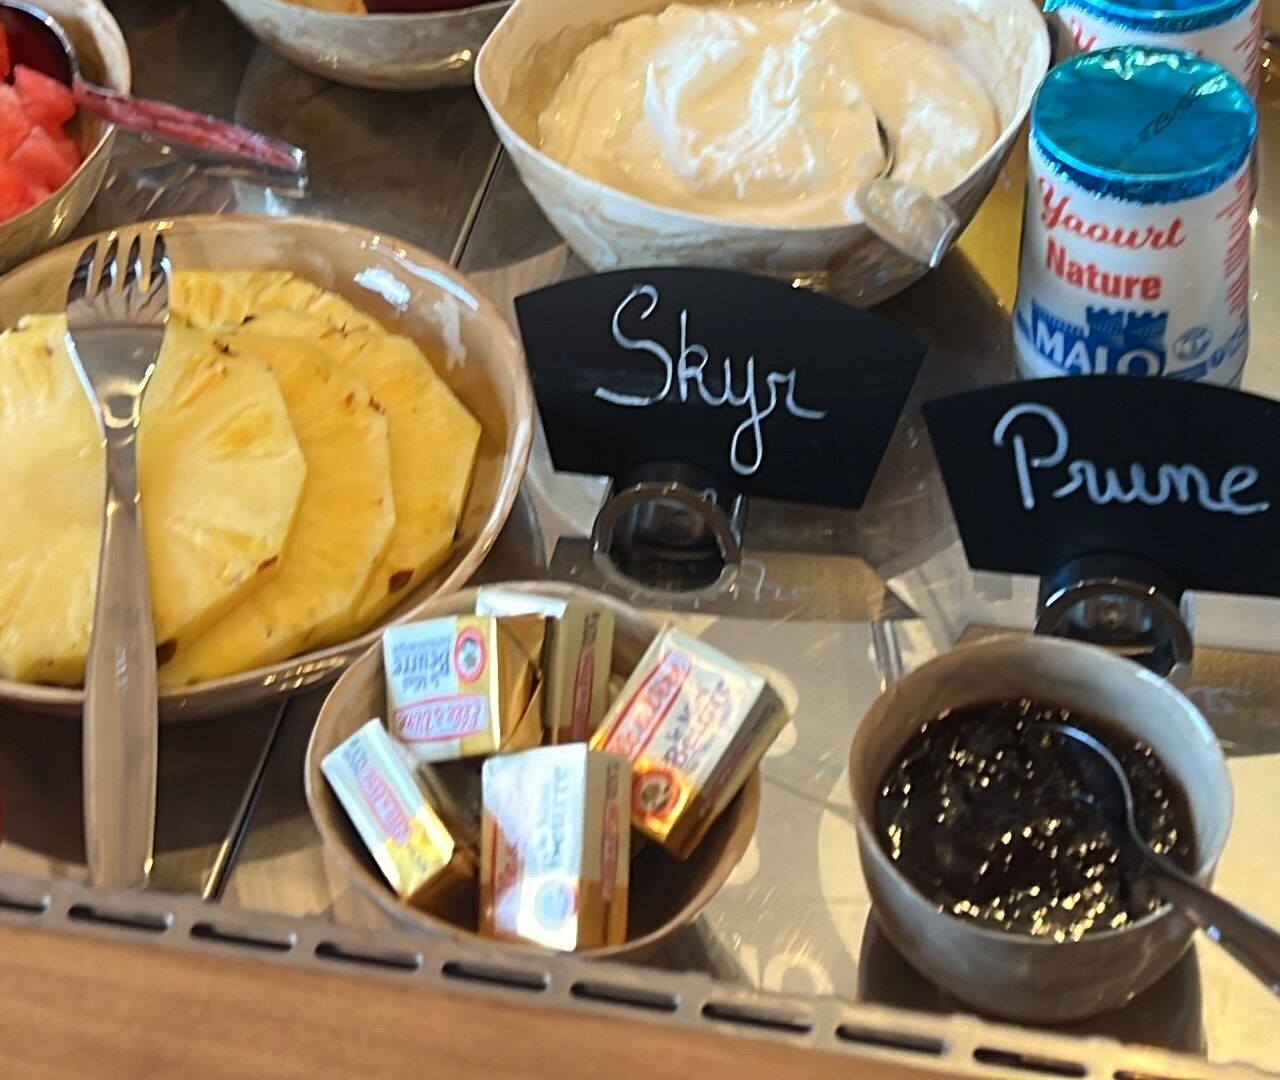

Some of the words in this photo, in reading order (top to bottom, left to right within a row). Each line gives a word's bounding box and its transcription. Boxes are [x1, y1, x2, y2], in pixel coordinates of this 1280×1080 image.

[1039, 176, 1186, 250] Yaourt
[1045, 237, 1162, 301] Nature
[594, 283, 829, 476] Skyr
[992, 402, 1272, 514] Prune
